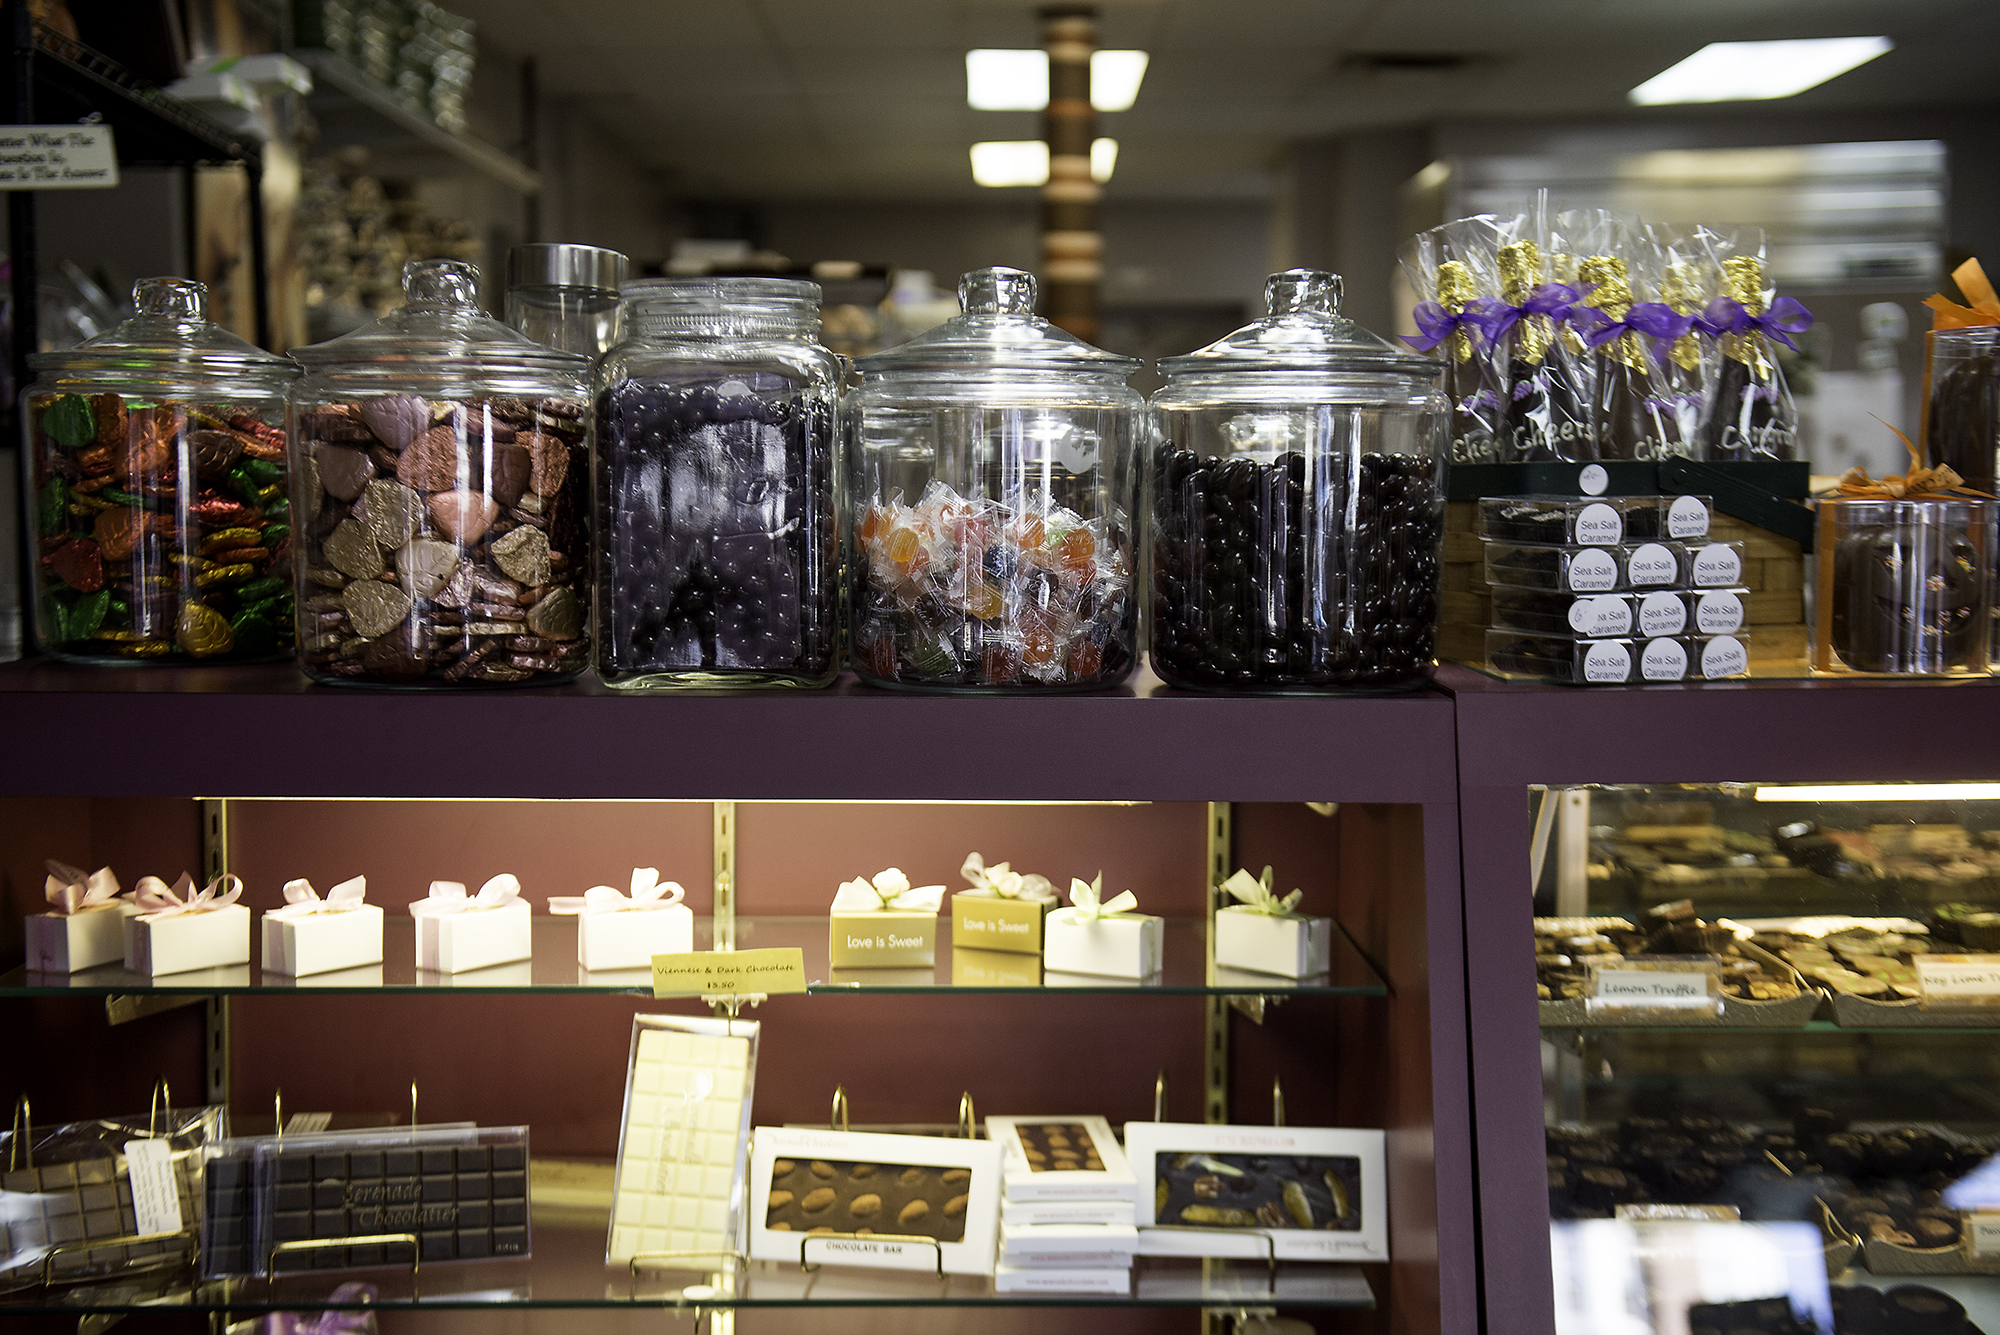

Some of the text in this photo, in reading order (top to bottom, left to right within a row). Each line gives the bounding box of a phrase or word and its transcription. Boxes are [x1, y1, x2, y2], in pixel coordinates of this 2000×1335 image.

[27, 132, 64, 146] What
[66, 132, 94, 145] The
[32, 165, 58, 178] The
[1672, 511, 1705, 523] Sea Salt
[1581, 519, 1618, 530] Sea Salt
[1672, 524, 1705, 535] Caramel
[1580, 533, 1617, 543] Caramel
[1574, 565, 1612, 576] Sea Salt
[1633, 560, 1672, 571] Sea Salt
[1698, 560, 1736, 571] Sea Salt
[1572, 578, 1611, 589] Caramel
[1633, 573, 1671, 584] Caramel
[1697, 572, 1735, 584] Caramel
[1643, 605, 1681, 619] Sea Salt
[1702, 604, 1739, 615] Sea Salt
[1597, 610, 1626, 622] ea Salt
[1643, 618, 1681, 631] Caramel
[1701, 617, 1738, 628] Caramel
[1589, 623, 1626, 635] Caramel
[1588, 656, 1626, 667] Sea Salt
[1645, 655, 1682, 666] Sea Salt
[1705, 649, 1742, 666] Sea Salt
[1587, 669, 1624, 680] Caramel
[1644, 666, 1680, 678] Caramel
[1706, 662, 1743, 678] Caramel
[963, 916, 1029, 934] Love is Sweet
[847, 933, 923, 948] Love is Sweet
[657, 964, 795, 975] Viennese & Dark Chocolate
[1951, 972, 1986, 984] Lime
[1605, 982, 1697, 996] Lemon Truffle
[342, 1176, 422, 1205] Serenade
[359, 1202, 460, 1227] Chocolatier
[826, 1240, 902, 1254] CHOCOLATE BAR
